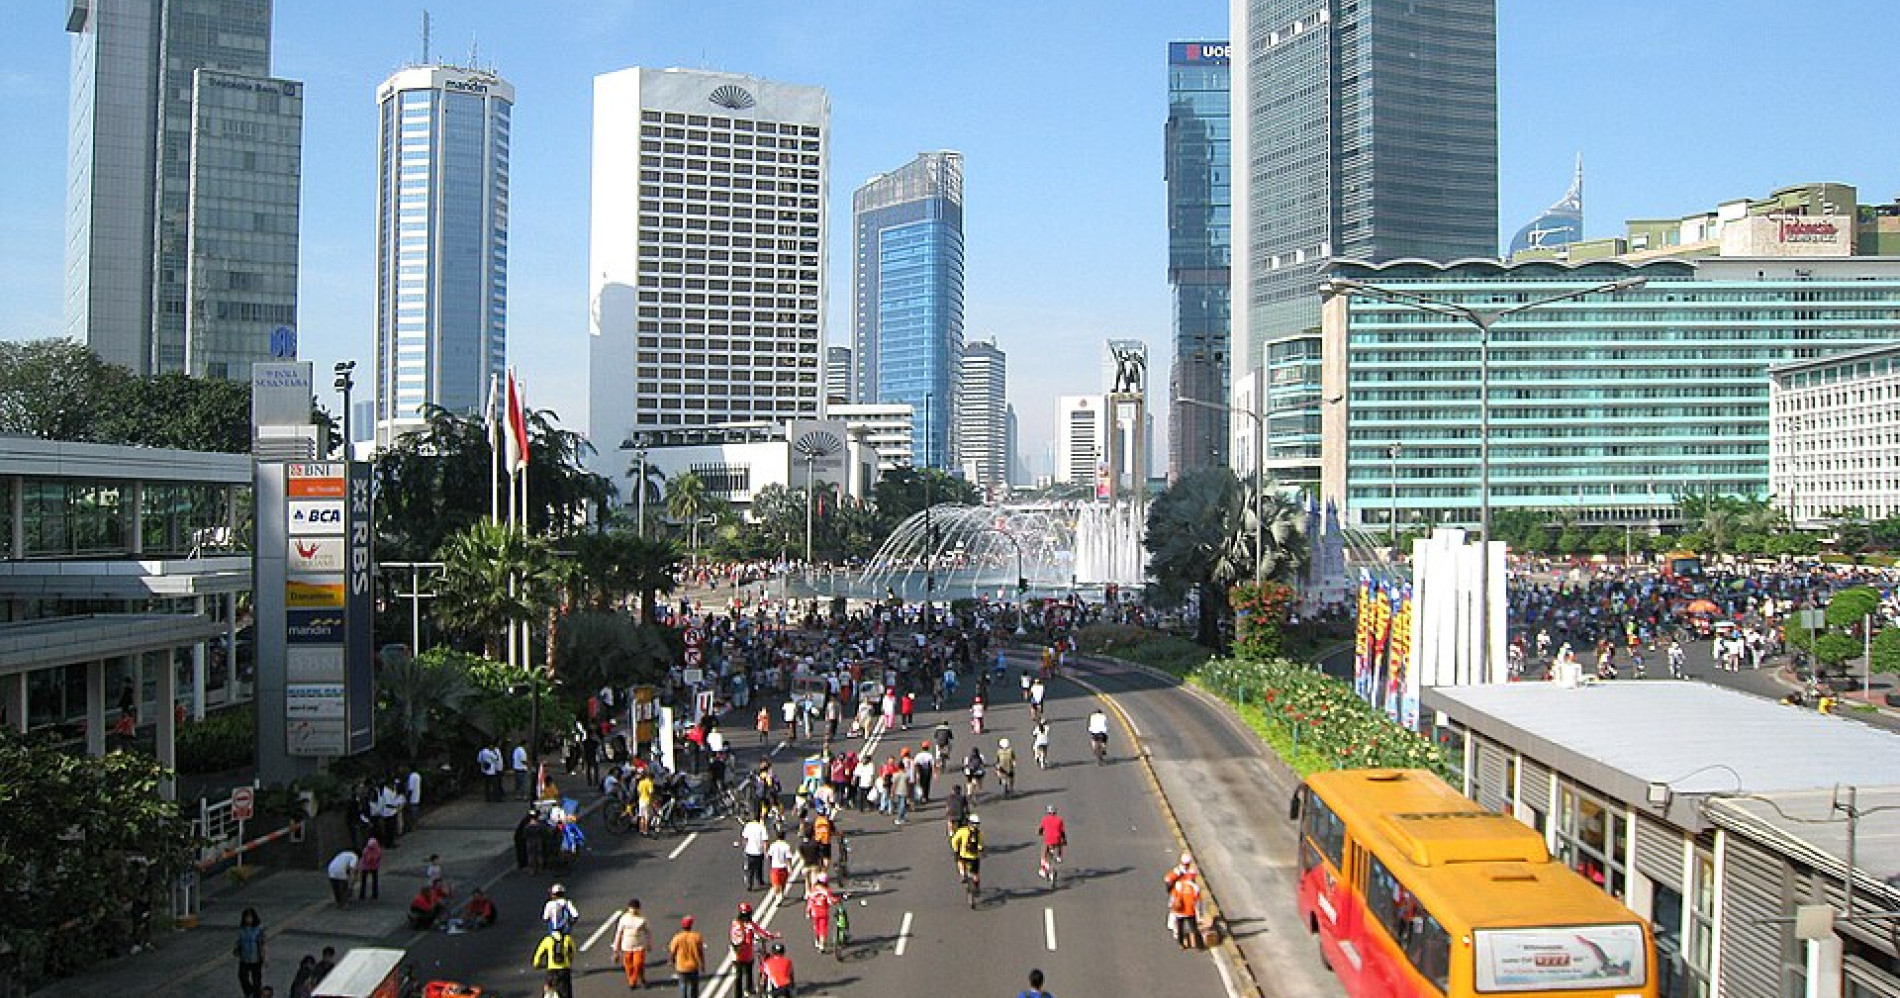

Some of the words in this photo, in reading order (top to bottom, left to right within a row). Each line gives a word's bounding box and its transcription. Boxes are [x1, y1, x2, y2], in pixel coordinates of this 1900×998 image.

[304, 464, 330, 477] BNI
[308, 508, 341, 522] BCA
[352, 520, 369, 596] RBS
[288, 625, 332, 636] mandiri
